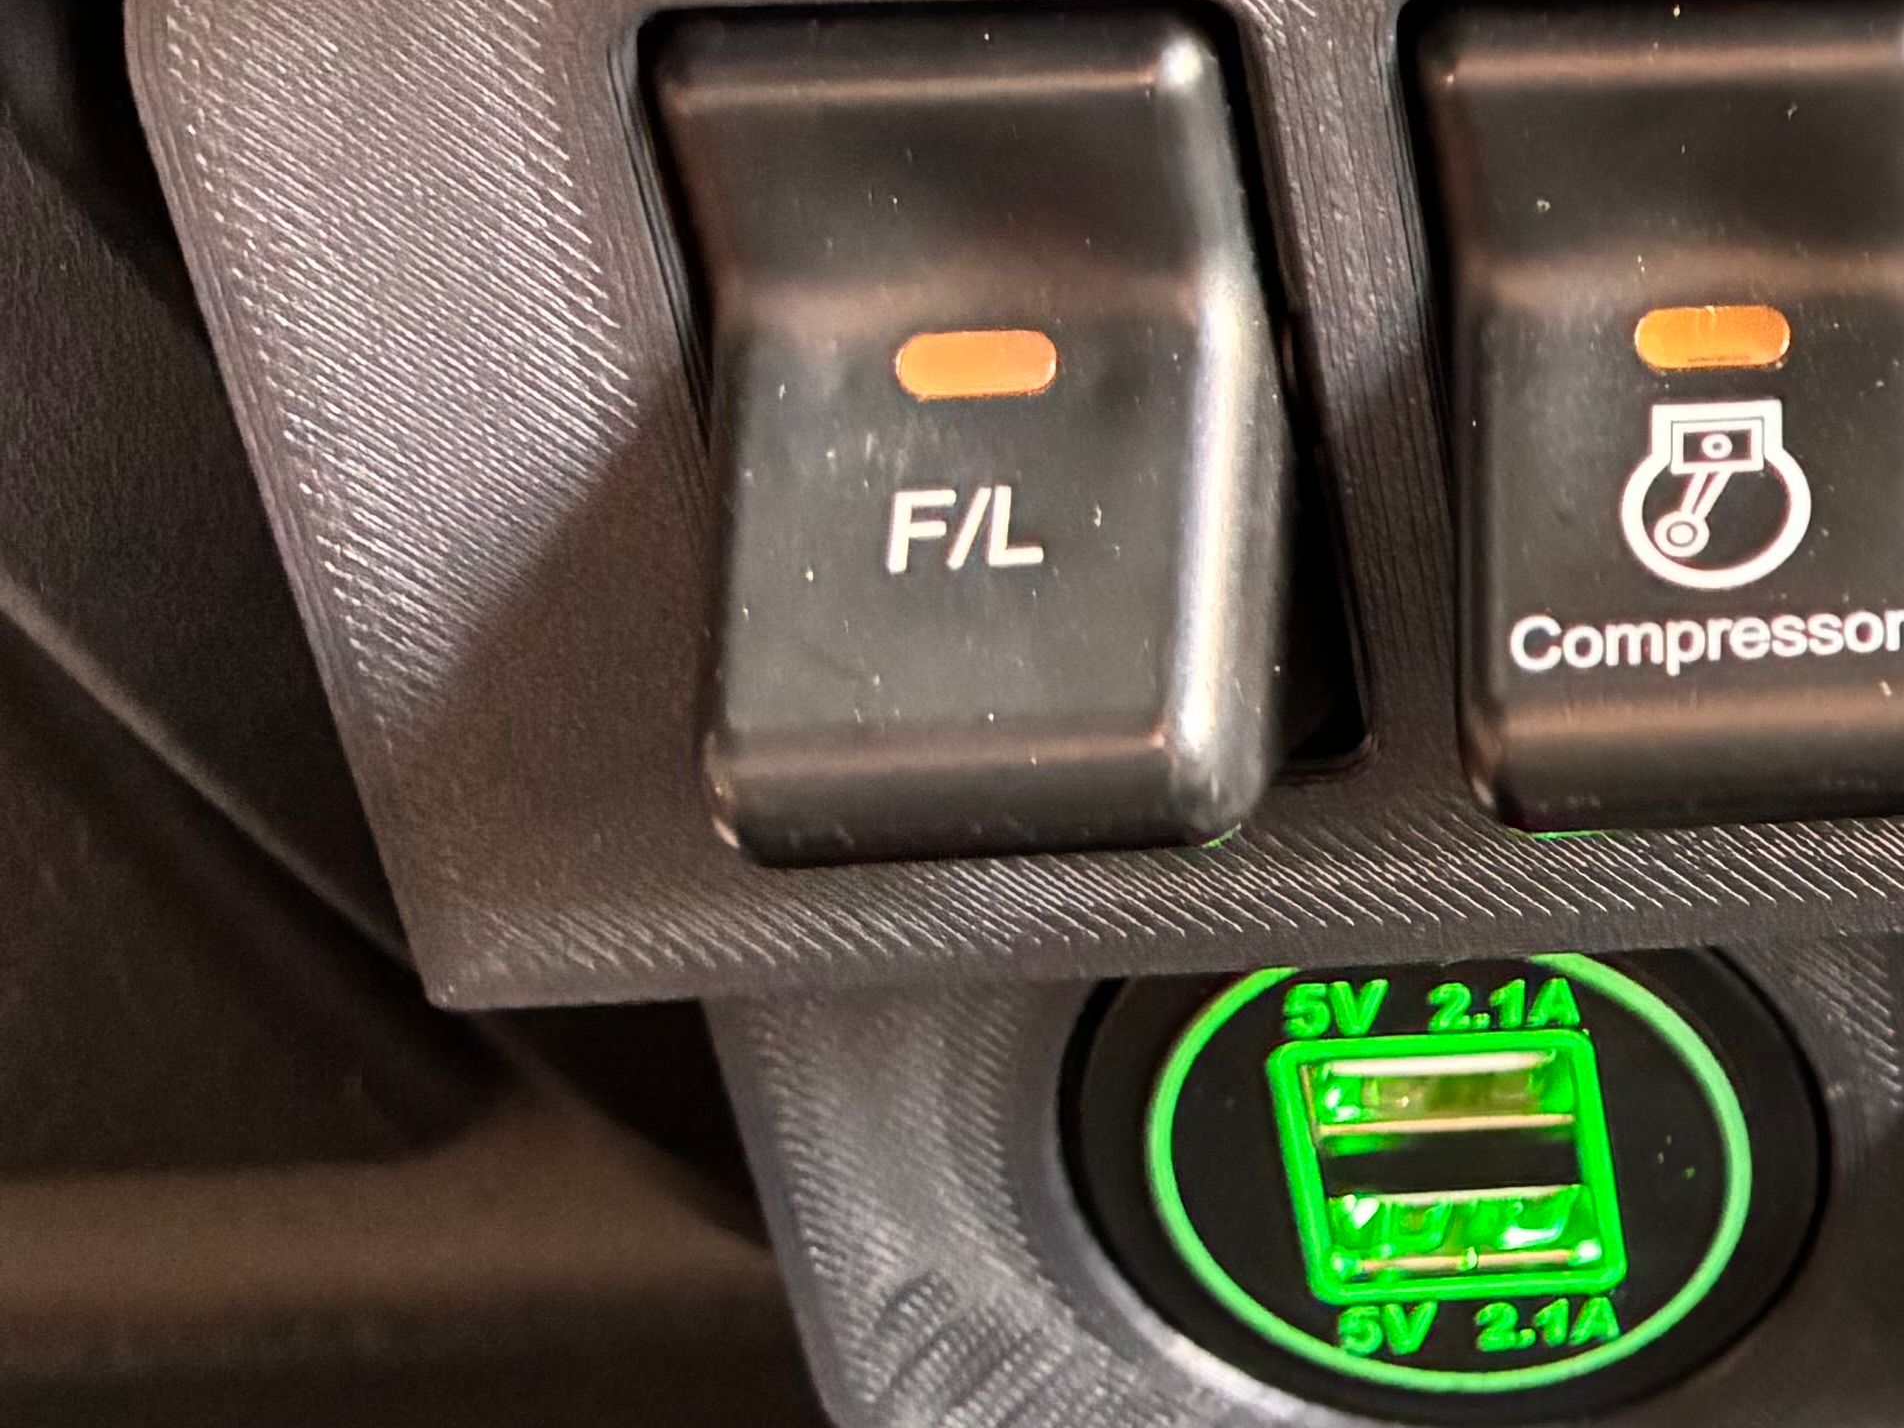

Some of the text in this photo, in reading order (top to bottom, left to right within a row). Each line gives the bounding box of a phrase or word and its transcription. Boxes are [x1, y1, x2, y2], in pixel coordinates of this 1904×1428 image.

[885, 485, 1046, 575] F/L
[1282, 977, 1582, 1038] 5V 2.1A
[1337, 1296, 1622, 1356] 5V 2.1A
